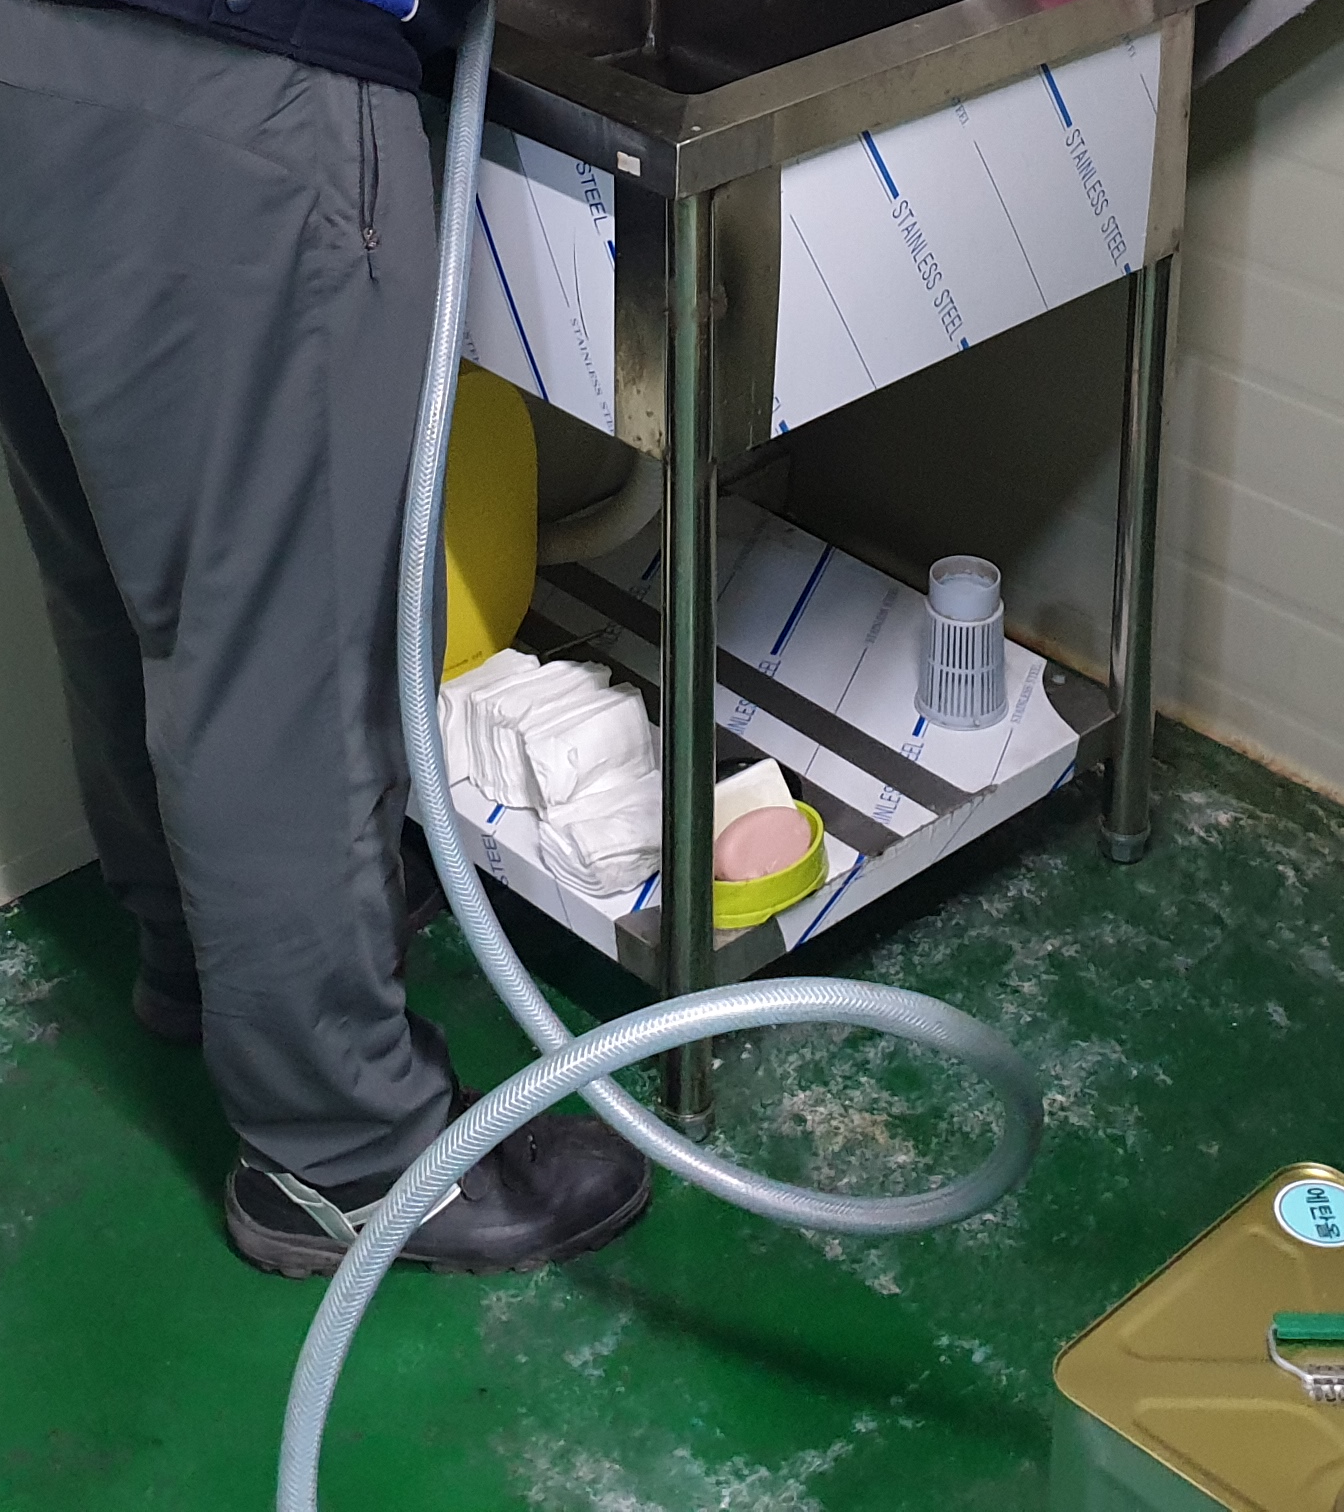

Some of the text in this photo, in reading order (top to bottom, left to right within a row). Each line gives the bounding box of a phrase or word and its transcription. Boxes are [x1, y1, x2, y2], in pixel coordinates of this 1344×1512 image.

[575, 161, 608, 235] STEEL
[1066, 128, 1127, 267] STAINLESS STEEL
[892, 199, 964, 342] STAINLESS STEEL
[570, 317, 604, 396] STAINLESS
[1305, 1187, 1341, 1239] 에탄올
